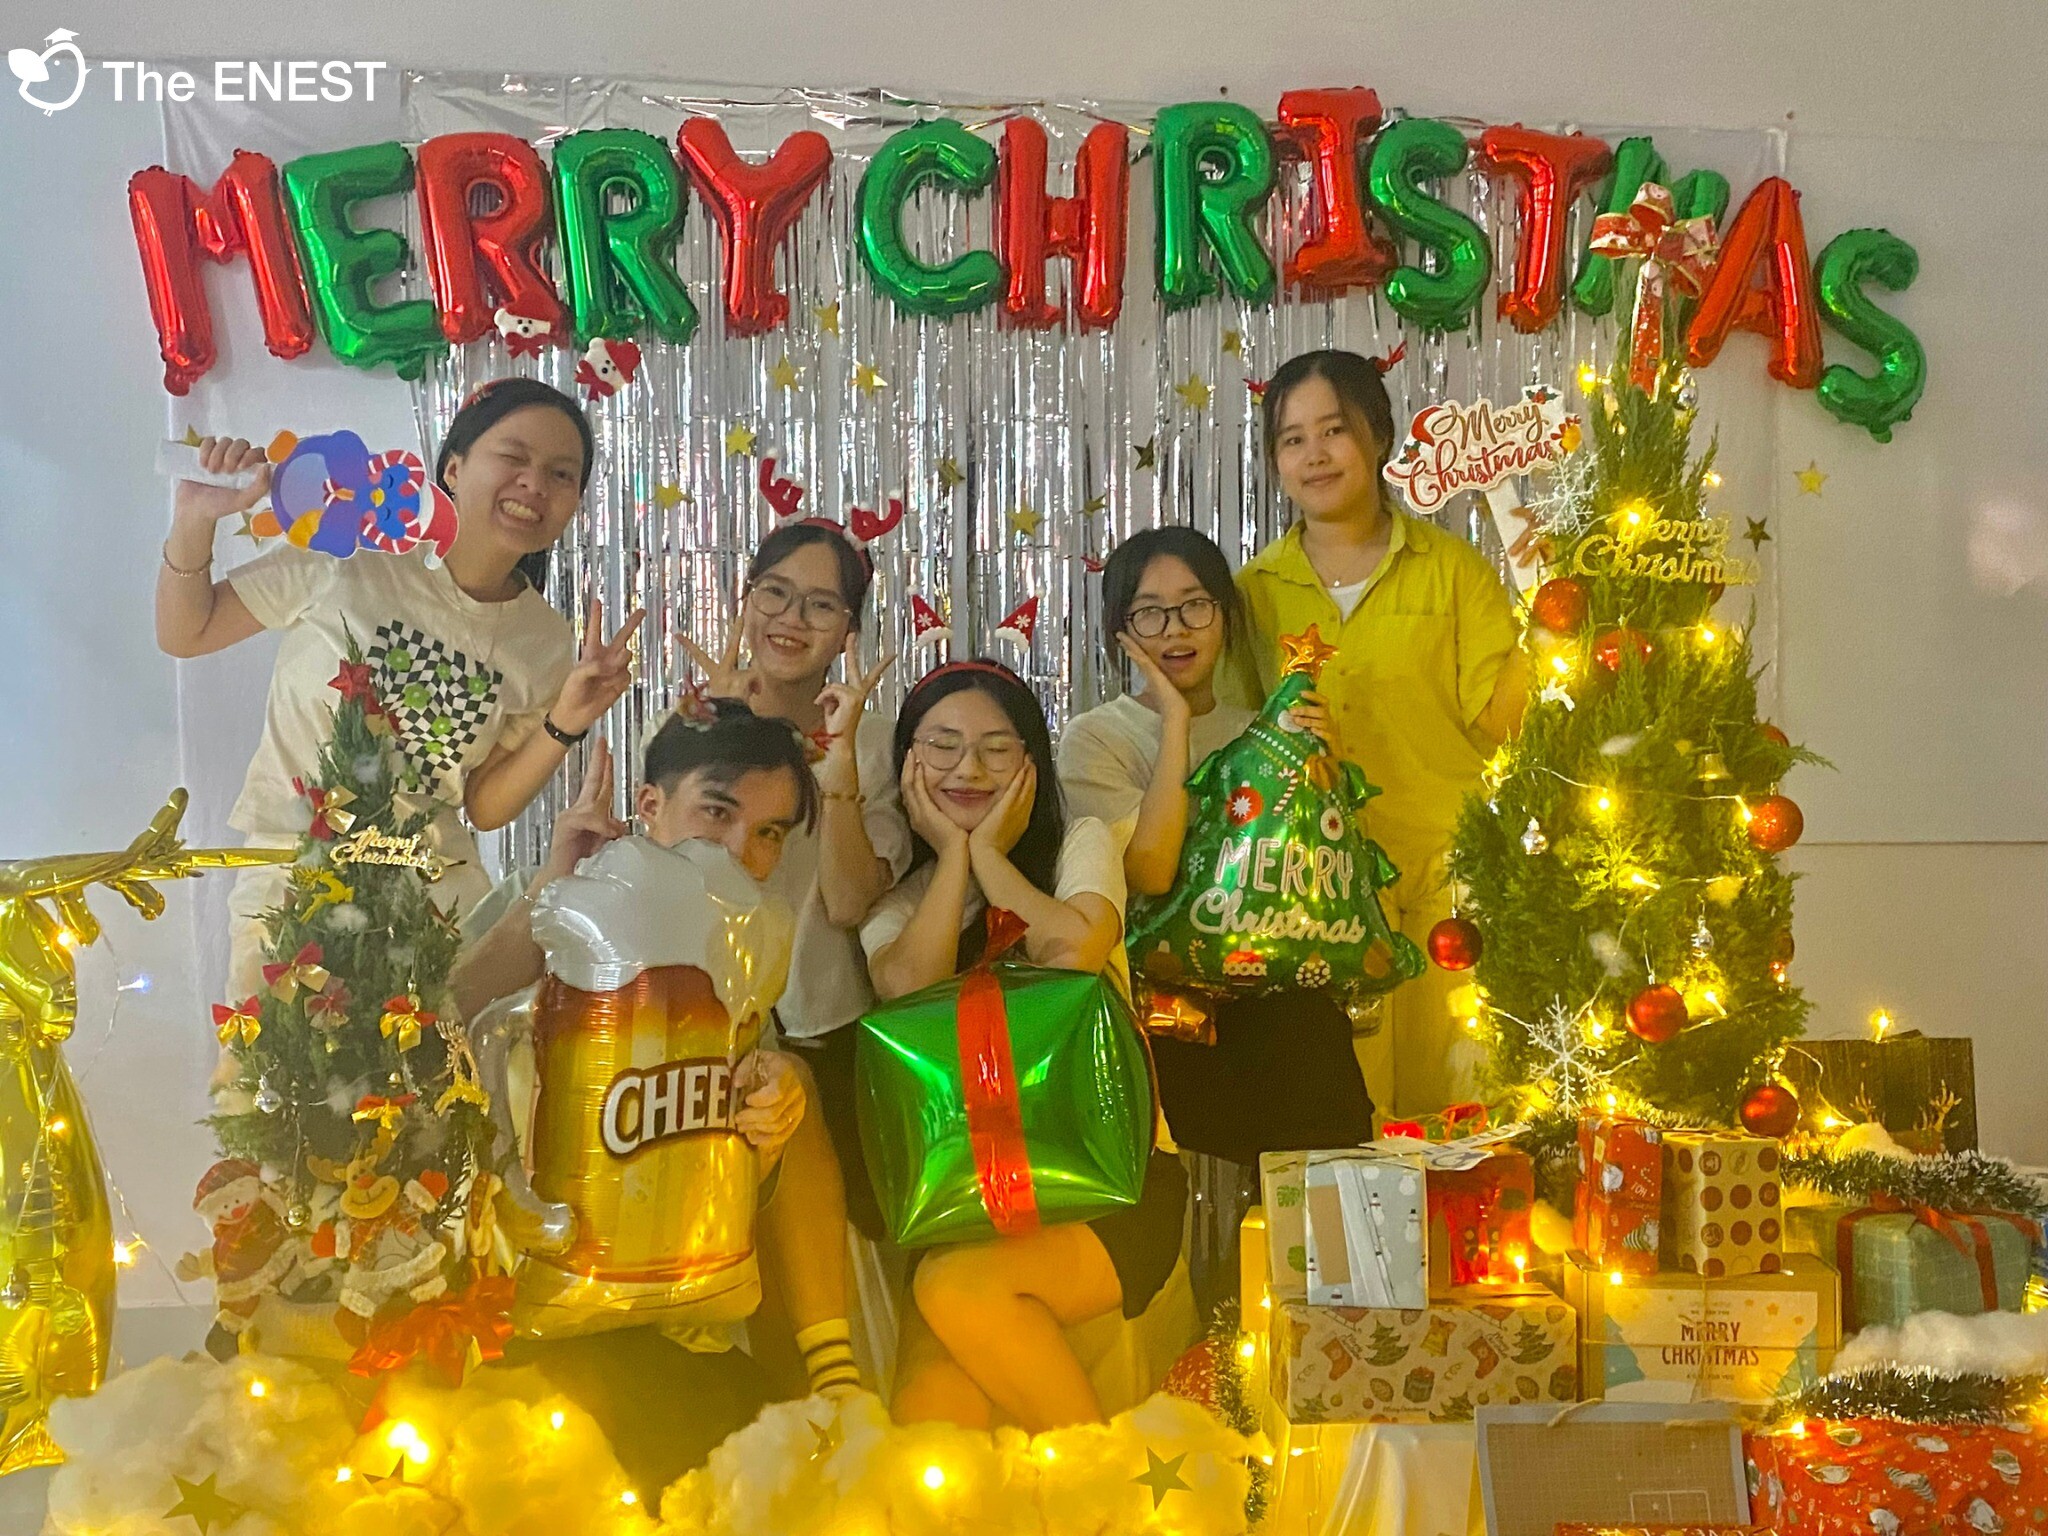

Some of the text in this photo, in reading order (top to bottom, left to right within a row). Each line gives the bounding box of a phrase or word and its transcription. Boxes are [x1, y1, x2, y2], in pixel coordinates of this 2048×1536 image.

[128, 116, 833, 397] MERRY
[1430, 403, 1550, 450] Merry
[1386, 438, 1555, 507] Christmas
[349, 825, 422, 857] Merry
[1213, 836, 1354, 901] MERRY
[1189, 886, 1367, 944] Christmas
[1661, 1346, 1760, 1367] CHRISTMAS
[1681, 1321, 1741, 1343] MERRY
